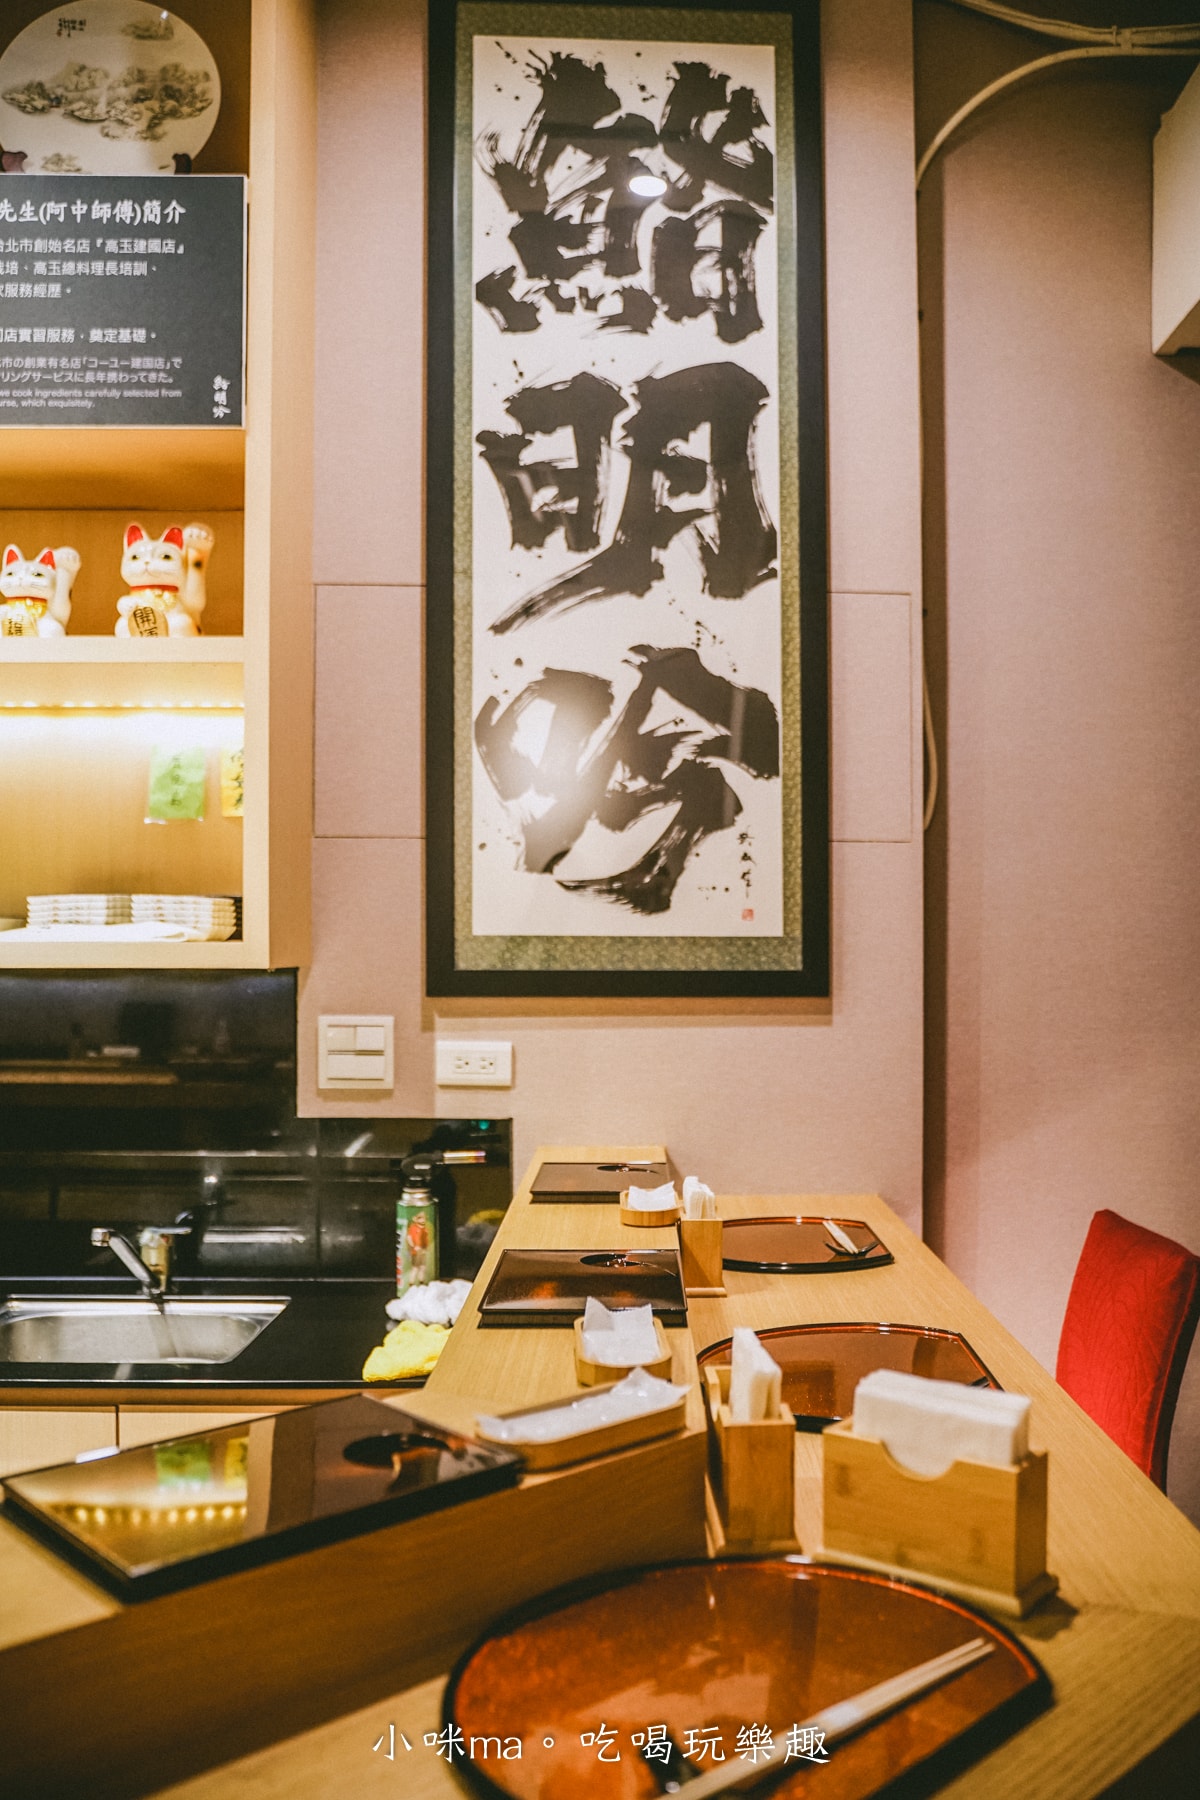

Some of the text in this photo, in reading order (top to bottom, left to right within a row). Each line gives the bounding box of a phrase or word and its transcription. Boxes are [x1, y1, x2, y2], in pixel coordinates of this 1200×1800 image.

[0, 282, 72, 298] 服務經歷。
[12, 388, 33, 398] cook
[34, 388, 82, 399] ingredients
[84, 388, 122, 400] carefully
[123, 388, 159, 398] selected
[161, 388, 182, 398] from
[21, 399, 46, 408] which
